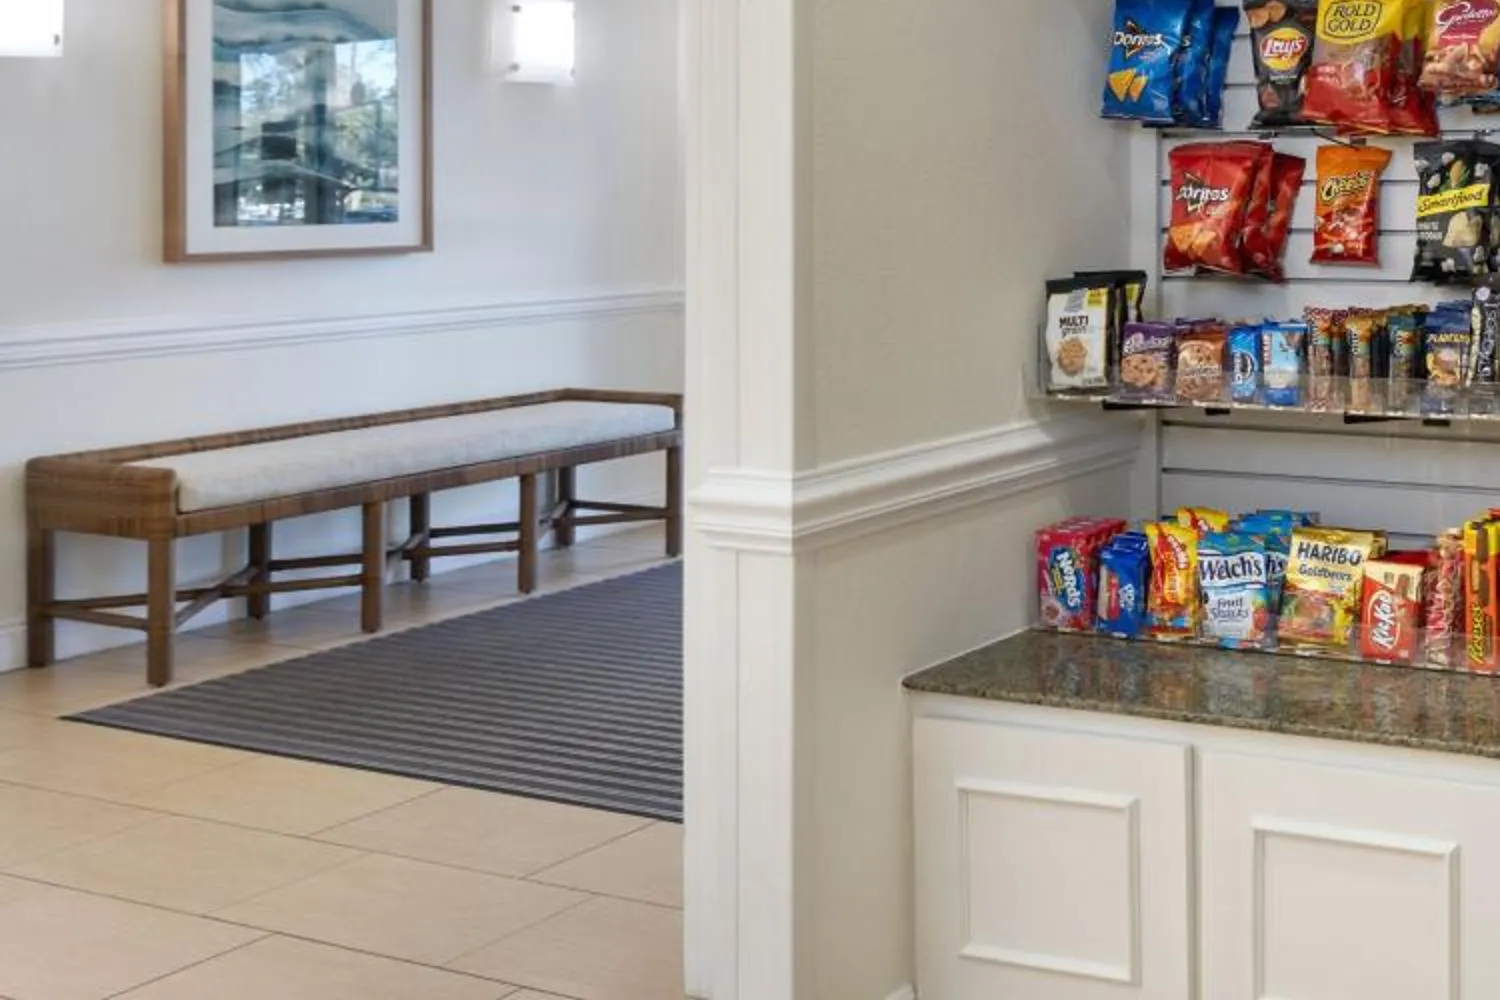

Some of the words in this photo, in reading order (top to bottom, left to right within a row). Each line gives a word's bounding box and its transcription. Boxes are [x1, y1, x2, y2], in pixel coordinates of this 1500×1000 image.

[1333, 1, 1377, 18] ROLD
[1327, 15, 1375, 33] GOLD
[1112, 30, 1163, 46] Doritos
[1264, 36, 1304, 58] Lay's
[1177, 186, 1231, 203] Doritos
[1419, 187, 1485, 213] Smartfood
[1059, 315, 1089, 327] MULTI
[1296, 541, 1362, 567] HARIBO
[1200, 555, 1264, 581] Welch's
[1057, 551, 1082, 611] Nerds
